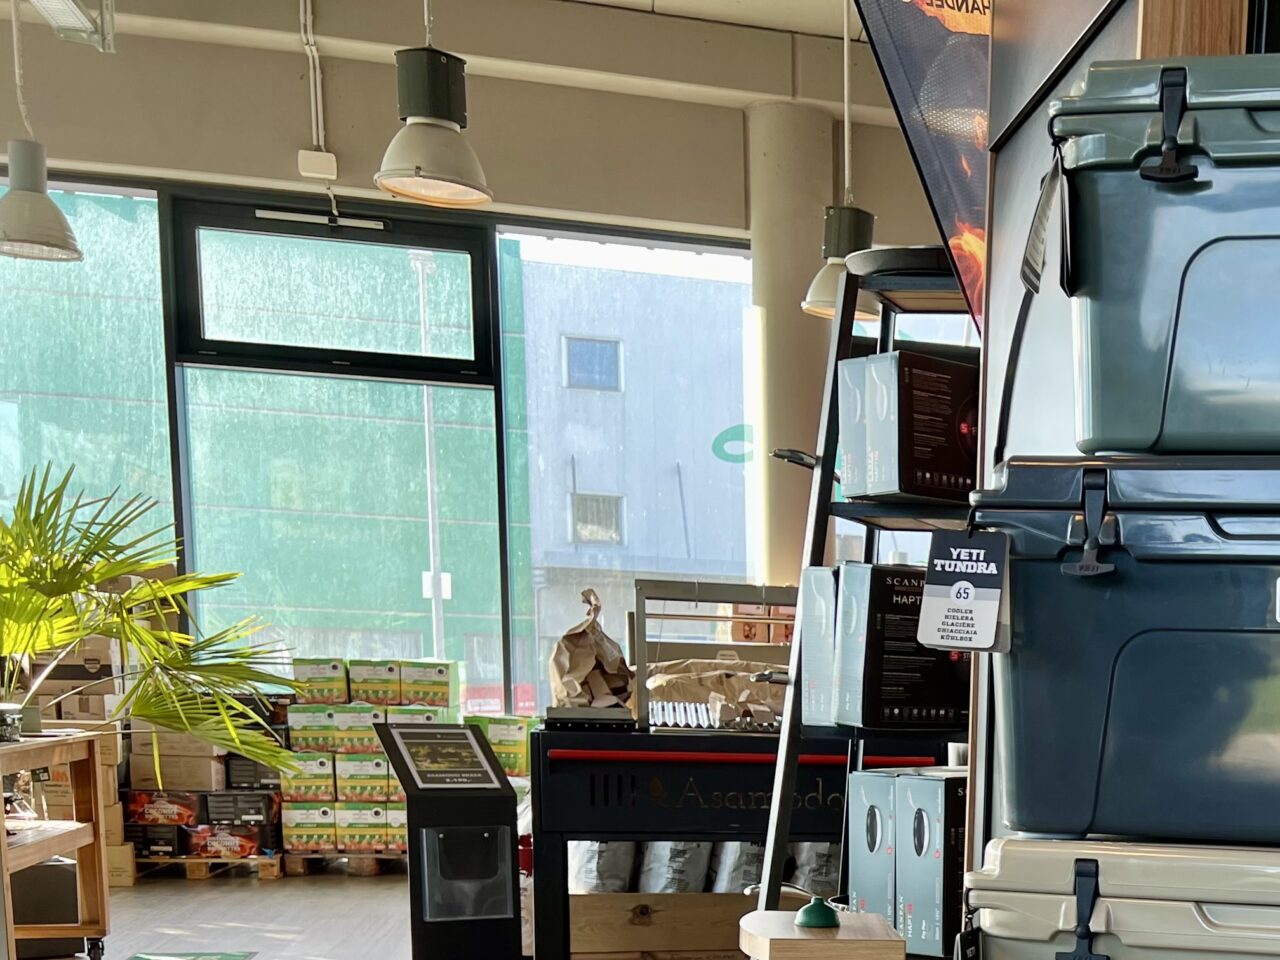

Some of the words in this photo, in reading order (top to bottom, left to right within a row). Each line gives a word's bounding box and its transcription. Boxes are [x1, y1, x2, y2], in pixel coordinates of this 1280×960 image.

[948, 547, 987, 561] YETI
[933, 558, 998, 575] TUNDRA
[955, 587, 971, 600] 65
[946, 607, 974, 615] COOLER
